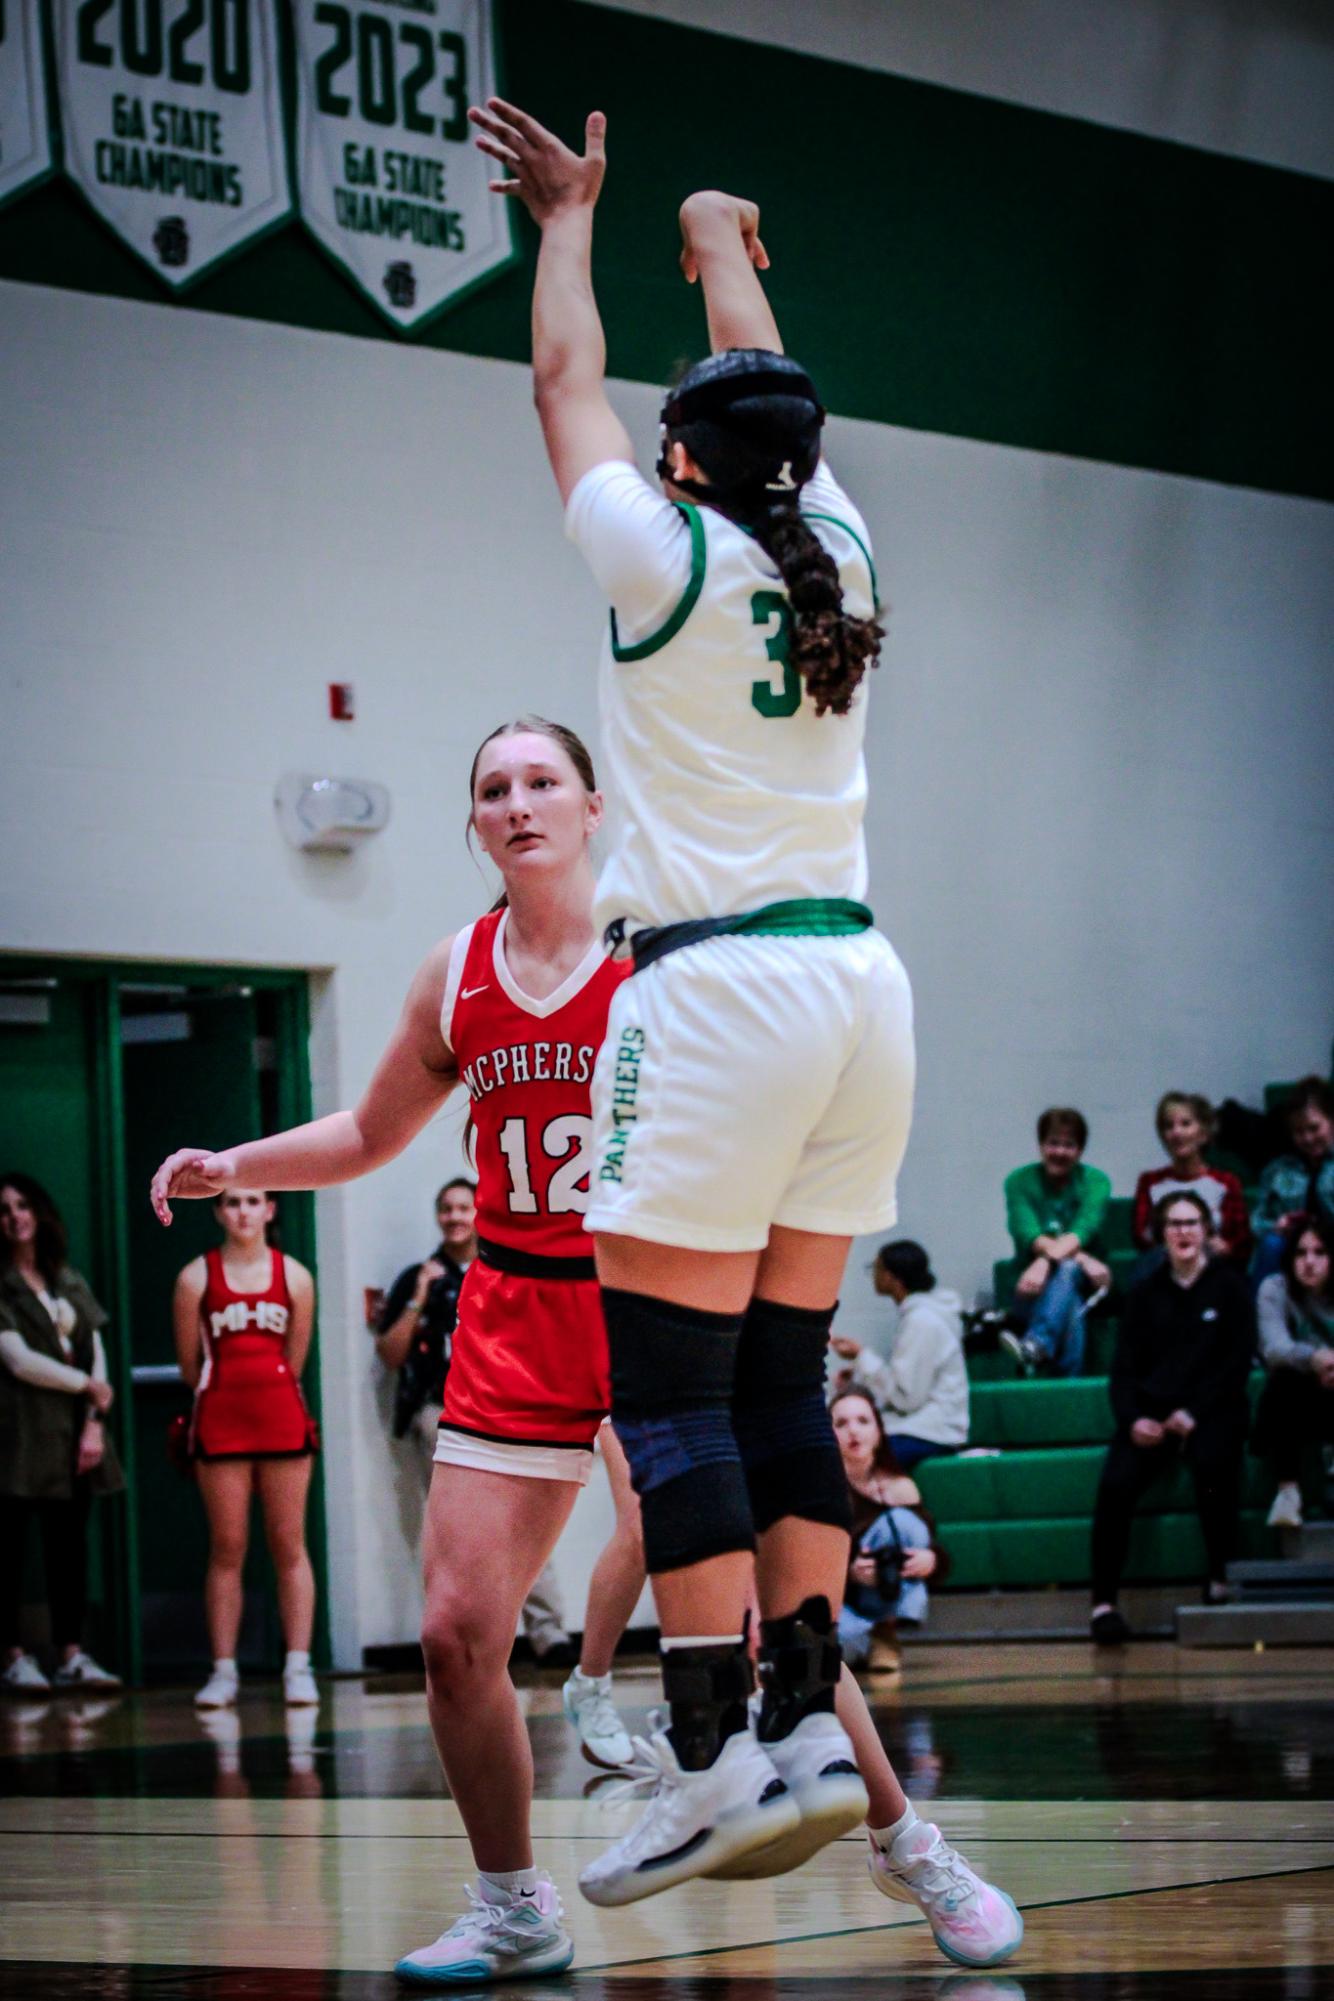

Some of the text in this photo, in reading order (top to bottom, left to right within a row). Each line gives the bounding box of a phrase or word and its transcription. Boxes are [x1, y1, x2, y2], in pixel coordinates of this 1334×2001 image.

[78, 0, 251, 95] 2020
[314, 3, 470, 142] 2023
[152, 101, 223, 157] STATE
[95, 138, 243, 208] CHAMPIONS
[384, 150, 445, 204] STATE
[334, 185, 465, 252] CHAMPIONS
[751, 590, 802, 718] 3
[463, 1041, 595, 1102] MCPHERS
[599, 1026, 646, 1183] PANTHERS
[499, 1113, 593, 1215] 12
[210, 1299, 289, 1339] MHS
